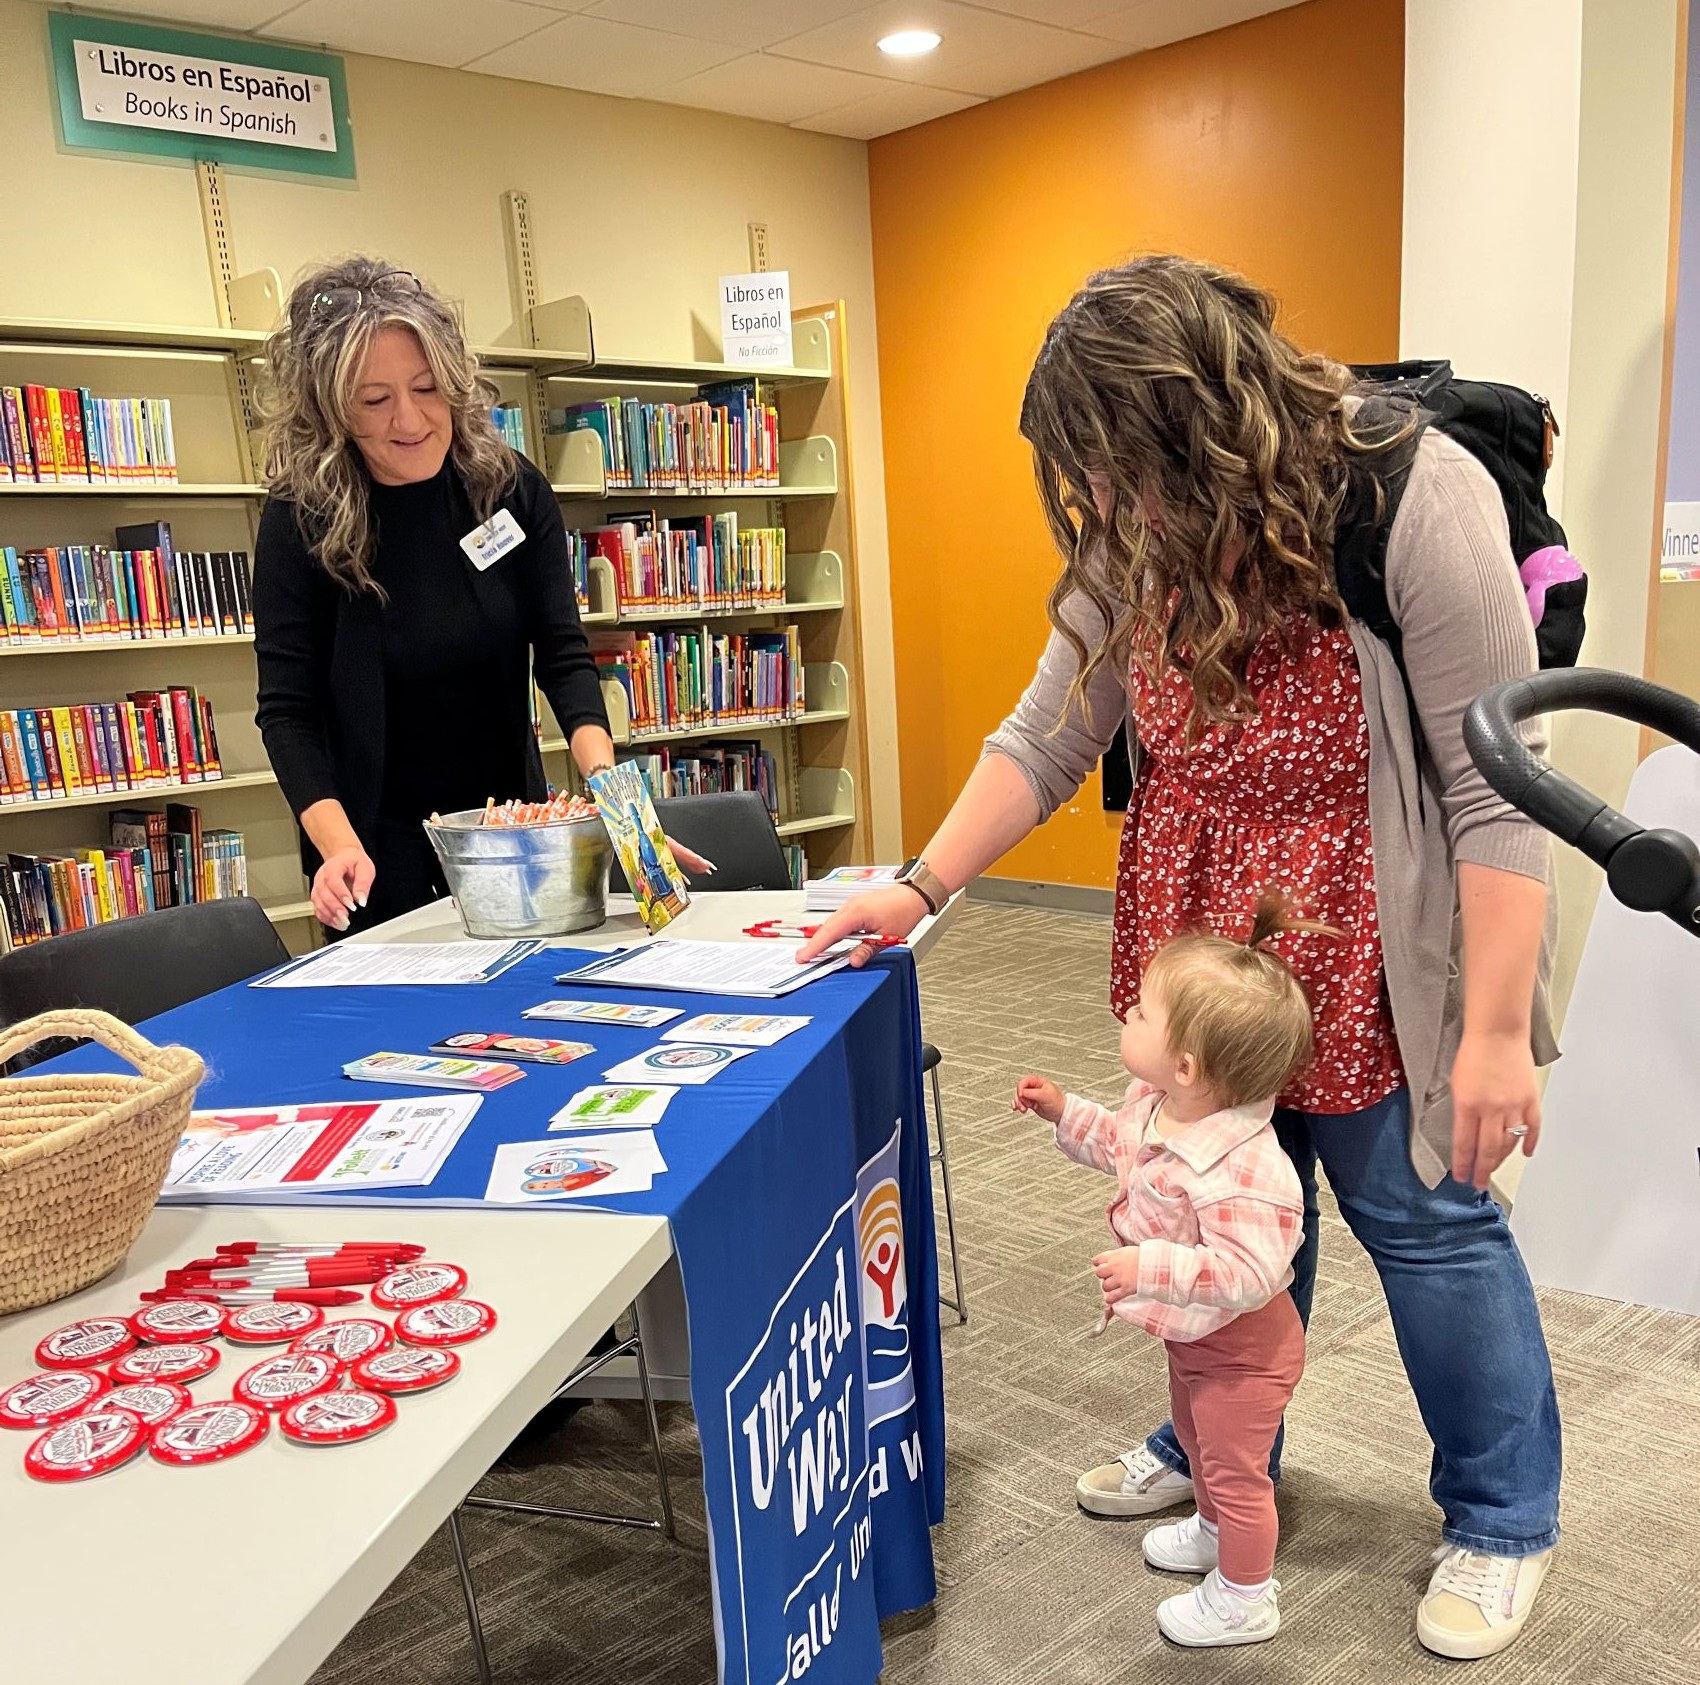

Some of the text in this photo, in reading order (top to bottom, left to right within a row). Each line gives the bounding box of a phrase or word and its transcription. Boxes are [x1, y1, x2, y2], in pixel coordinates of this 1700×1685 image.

[98, 49, 311, 103] Libros en Español
[125, 92, 297, 136] Books in Spanish
[726, 286, 784, 303] Libros en
[732, 311, 781, 334] Español
[738, 345, 778, 357] No Ficción
[3, 577, 12, 605] SUNNY
[743, 1246, 852, 1510] United
[788, 1373, 853, 1537] Way
